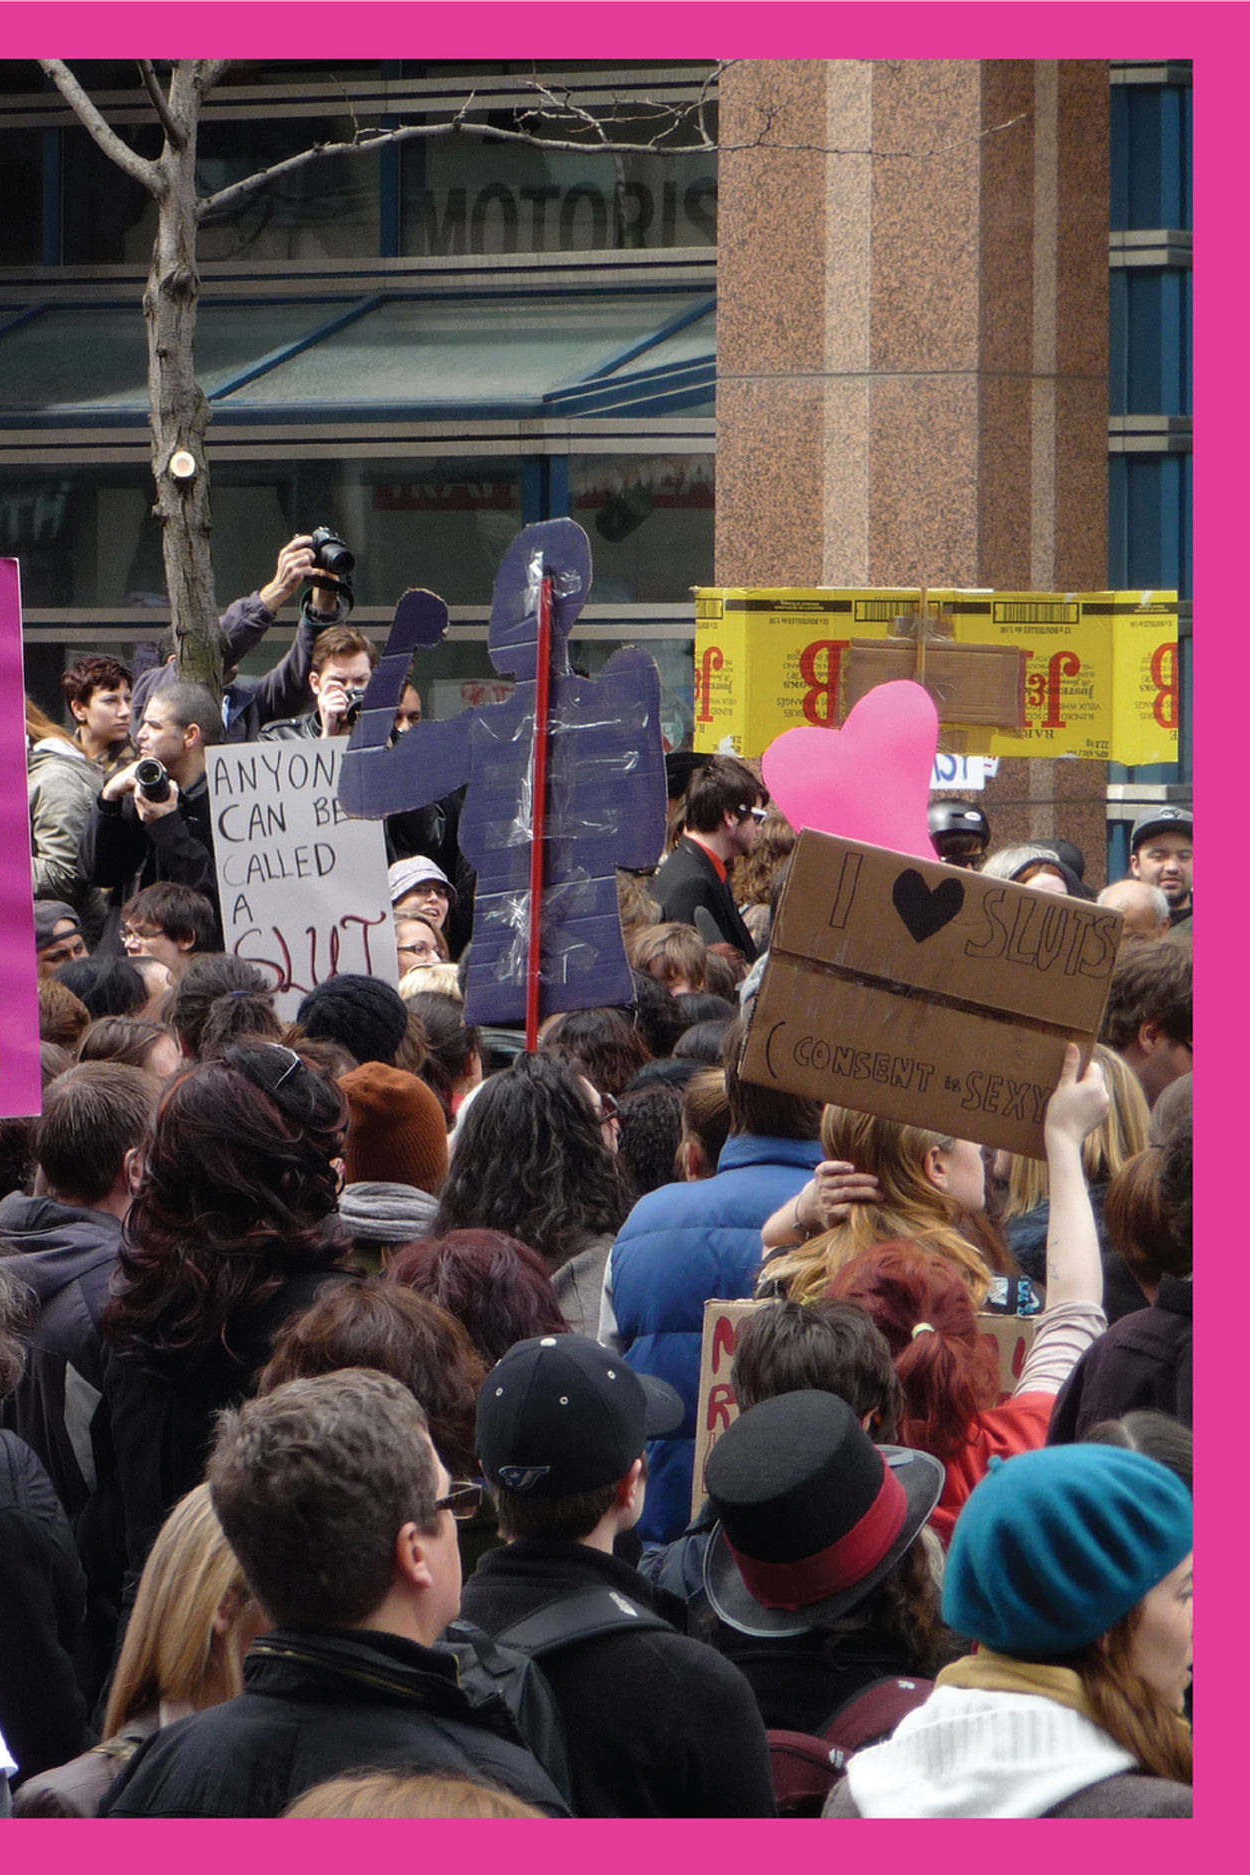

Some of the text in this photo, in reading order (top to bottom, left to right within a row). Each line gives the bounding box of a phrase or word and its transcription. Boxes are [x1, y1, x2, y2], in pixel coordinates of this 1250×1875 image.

[215, 750, 335, 796] ANYON
[218, 801, 286, 842] CAN
[223, 843, 336, 887] CALLED
[233, 893, 254, 925] A
[829, 852, 1117, 979] I SLUTS
[234, 911, 386, 993] SLUT
[944, 1075, 961, 1093] is
[961, 1070, 1054, 1125] SEXY
